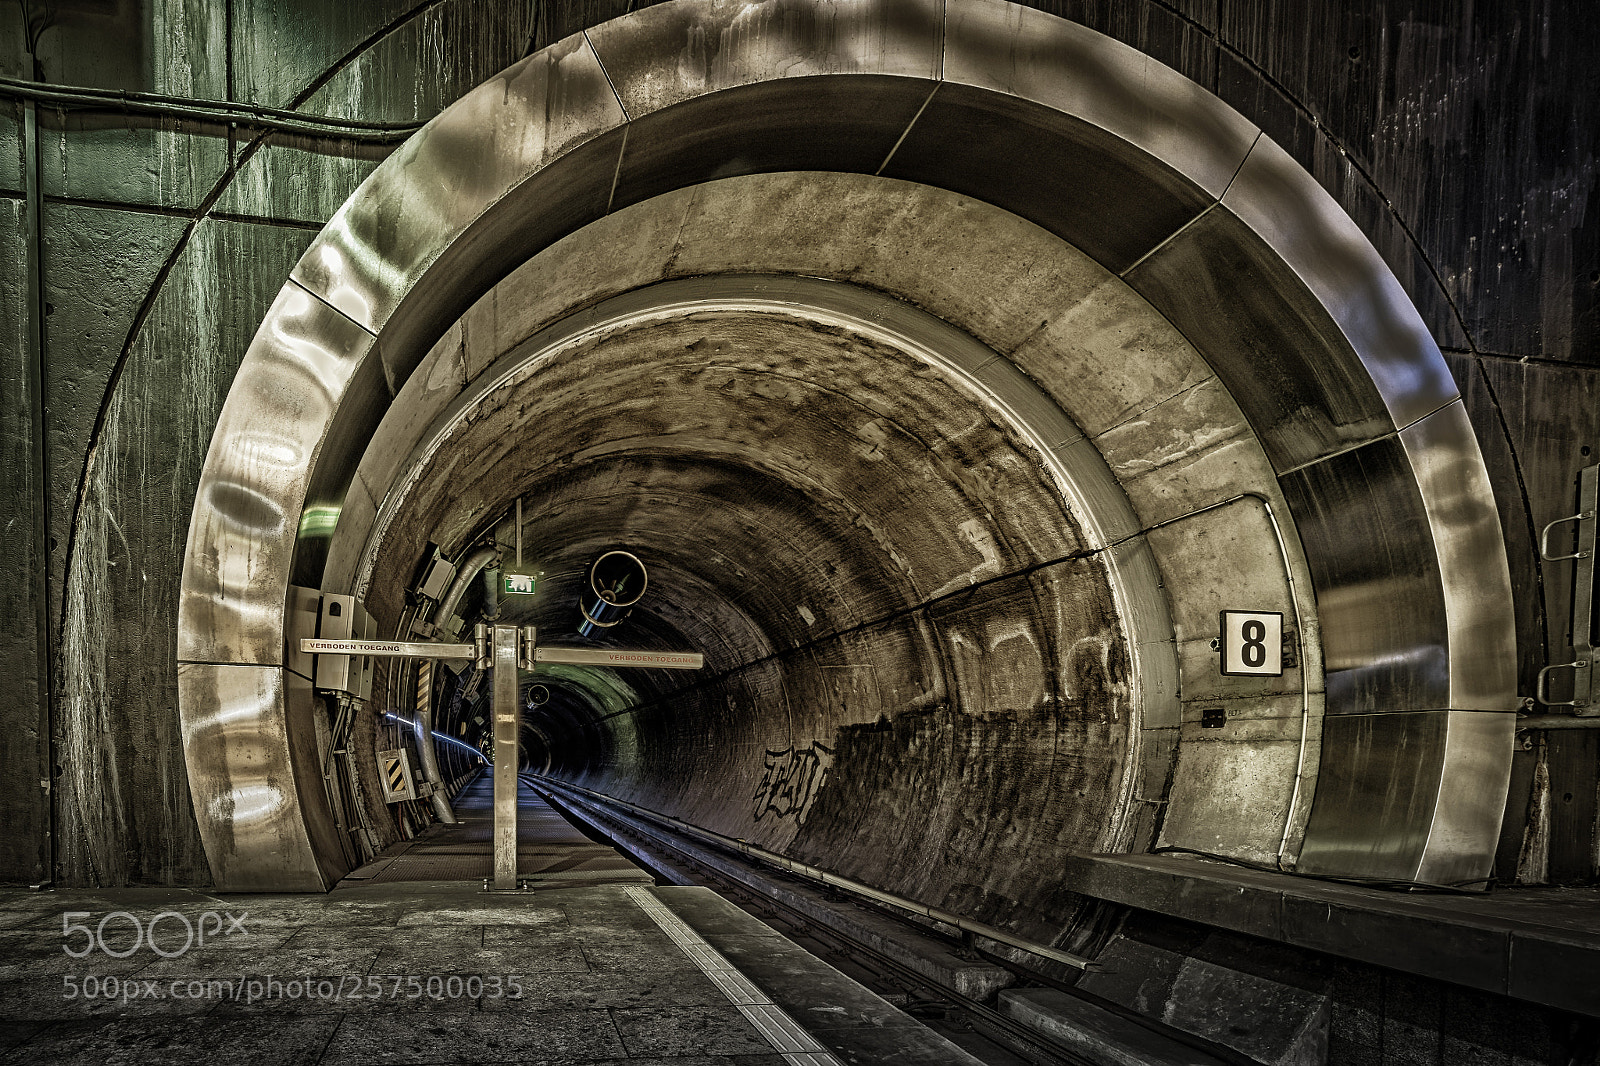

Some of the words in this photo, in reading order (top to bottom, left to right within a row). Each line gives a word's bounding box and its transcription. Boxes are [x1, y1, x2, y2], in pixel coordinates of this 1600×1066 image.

[1241, 620, 1266, 667] 8
[360, 644, 400, 652] TOEGANG
[609, 654, 653, 662] VERBODEN
